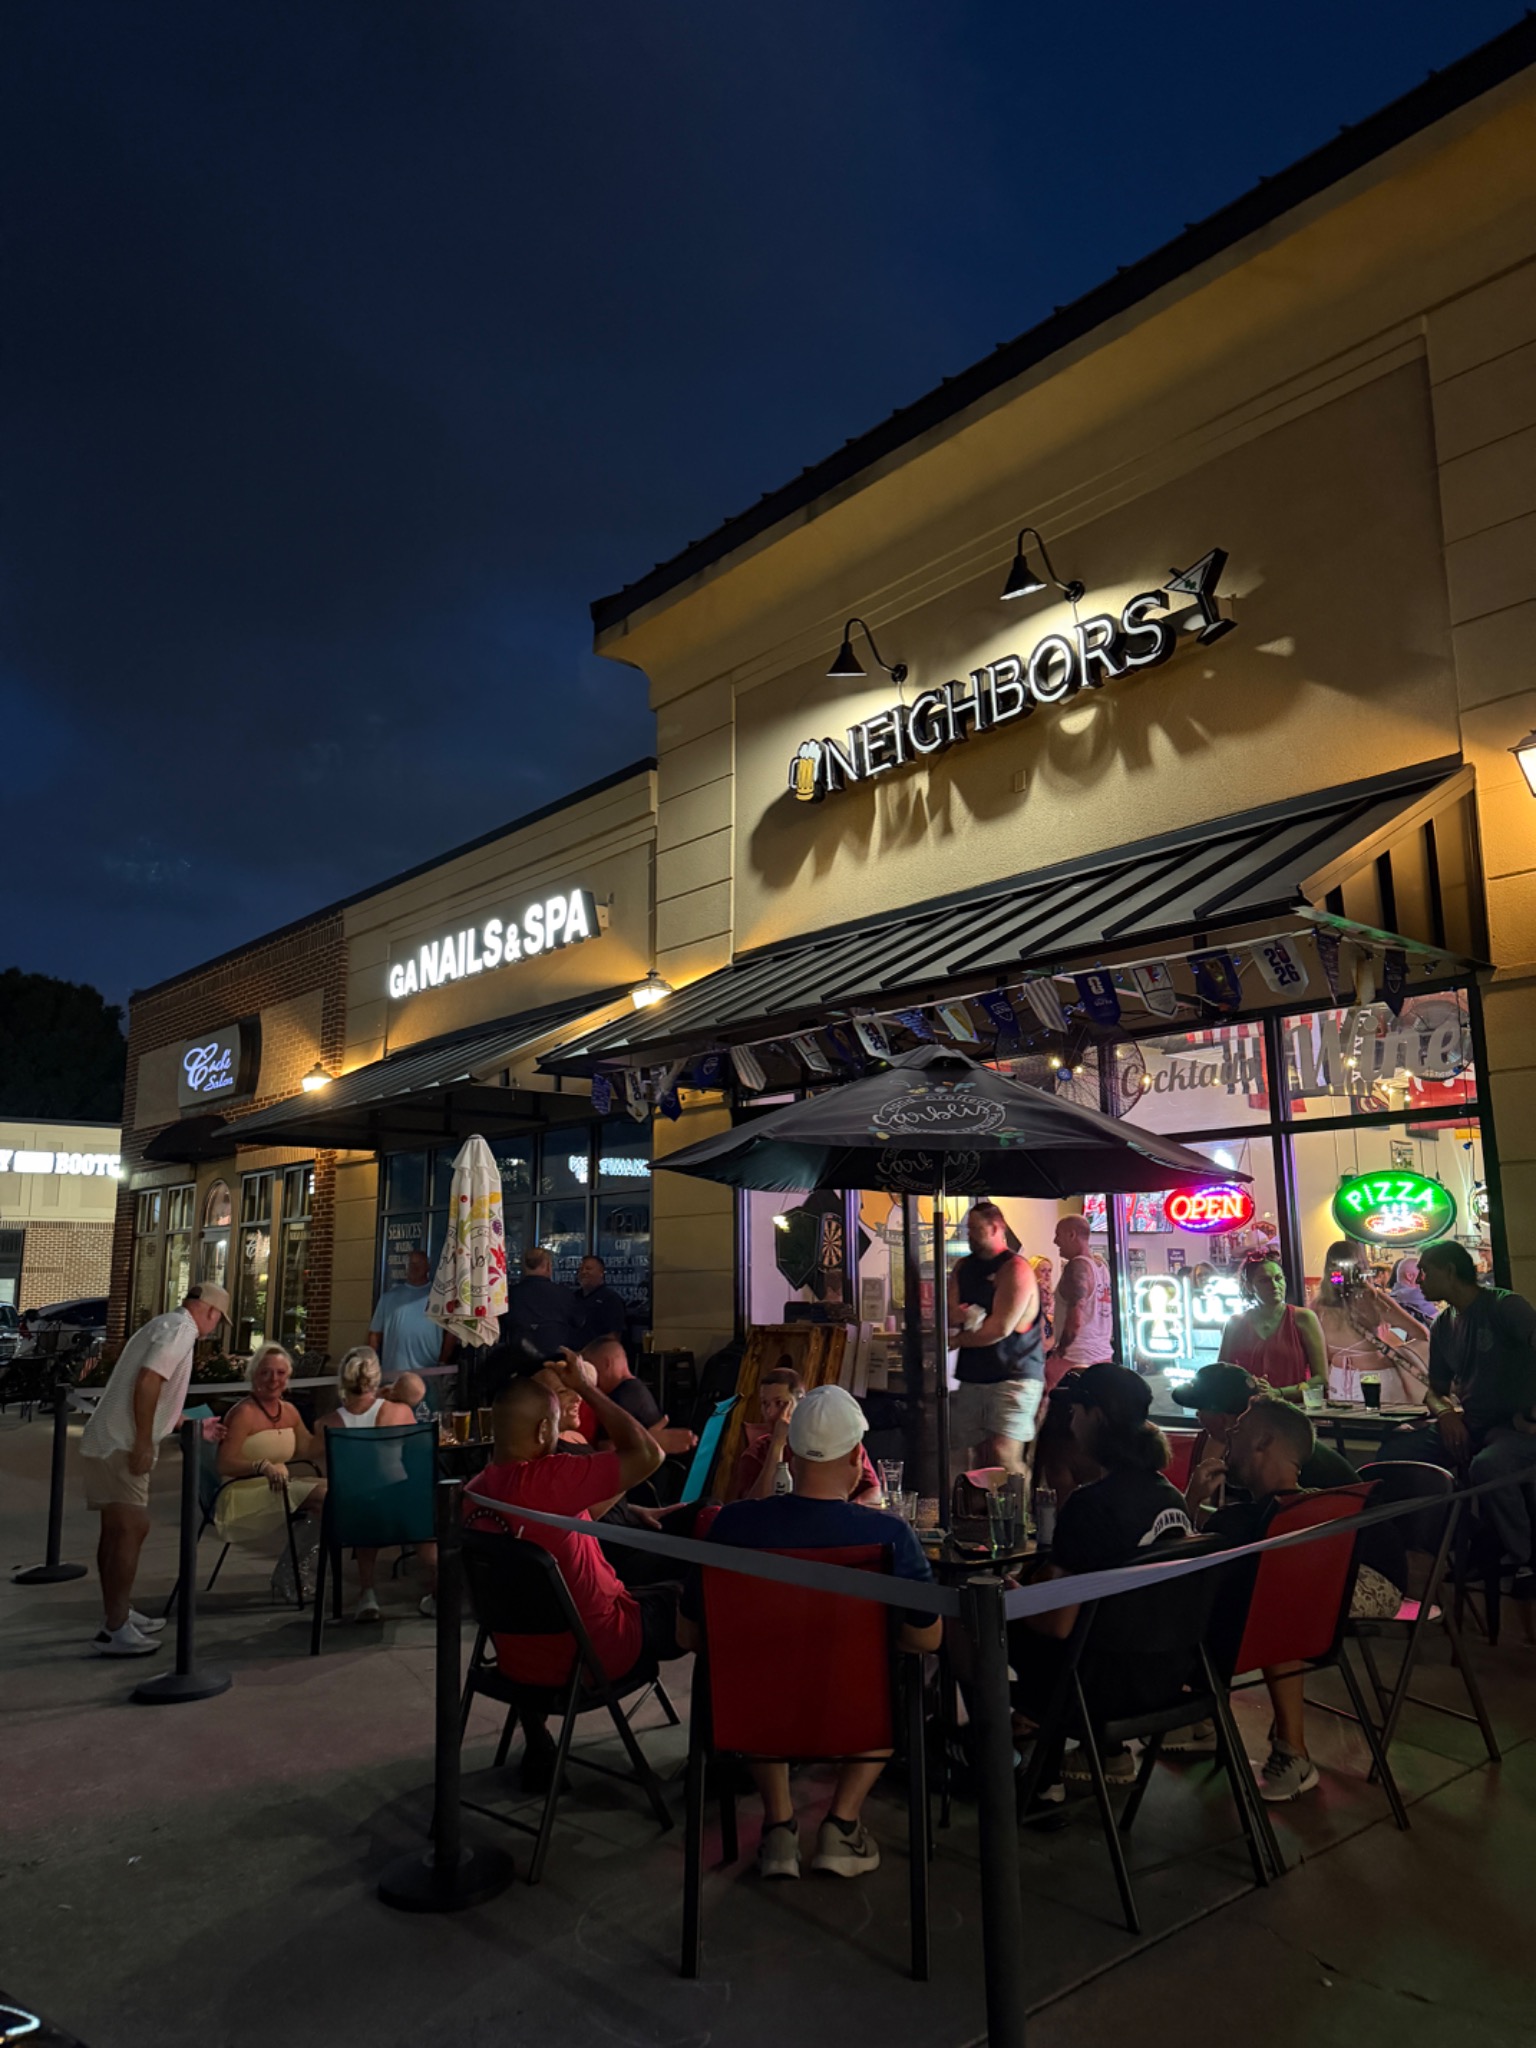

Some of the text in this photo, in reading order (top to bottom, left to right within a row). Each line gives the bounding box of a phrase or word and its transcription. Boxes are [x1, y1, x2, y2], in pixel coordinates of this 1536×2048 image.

[824, 590, 1176, 792] NEIGHBORS
[1284, 1011, 1464, 1091] Wine
[1170, 1194, 1244, 1221] OPEN
[1345, 1181, 1435, 1212] PIZZA
[388, 1223, 422, 1240] SERVICES
